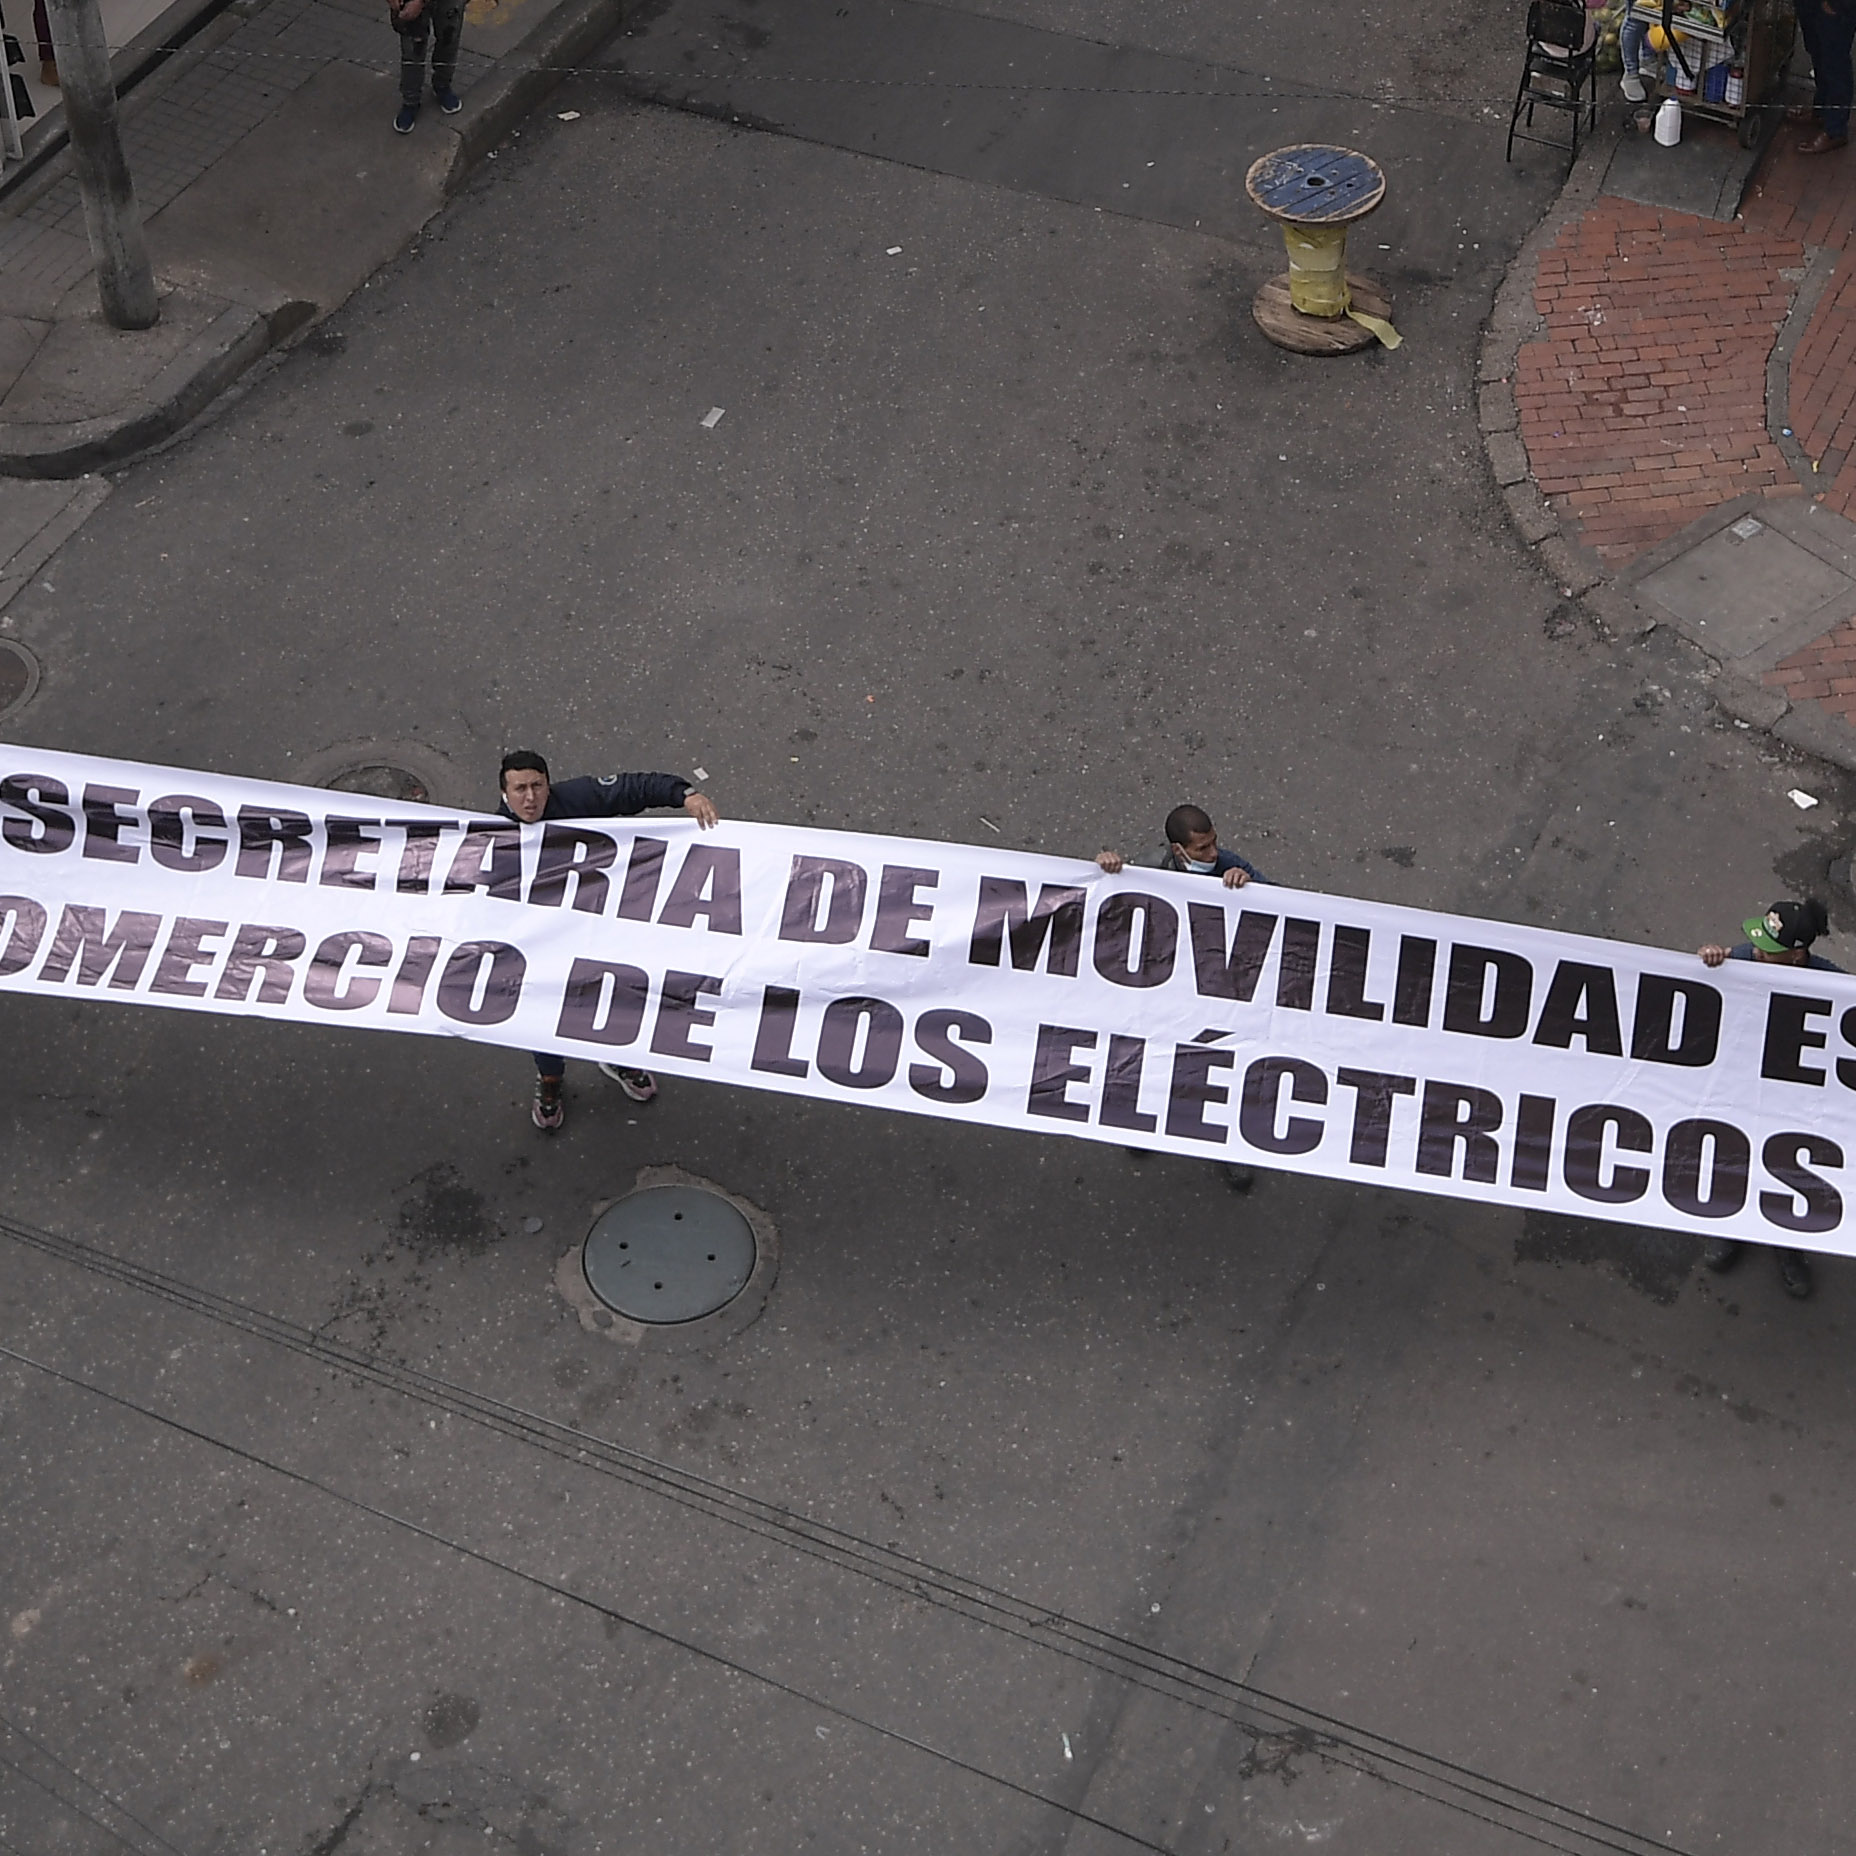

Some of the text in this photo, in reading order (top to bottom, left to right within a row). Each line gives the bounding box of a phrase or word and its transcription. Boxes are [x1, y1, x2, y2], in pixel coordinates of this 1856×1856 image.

[778, 854, 942, 958] DE
[968, 874, 1722, 1068] MOVILIDAD
[554, 957, 724, 1063] DE
[750, 984, 993, 1106] LOS
[1024, 1021, 1844, 1234] ELÉCTRICOS
